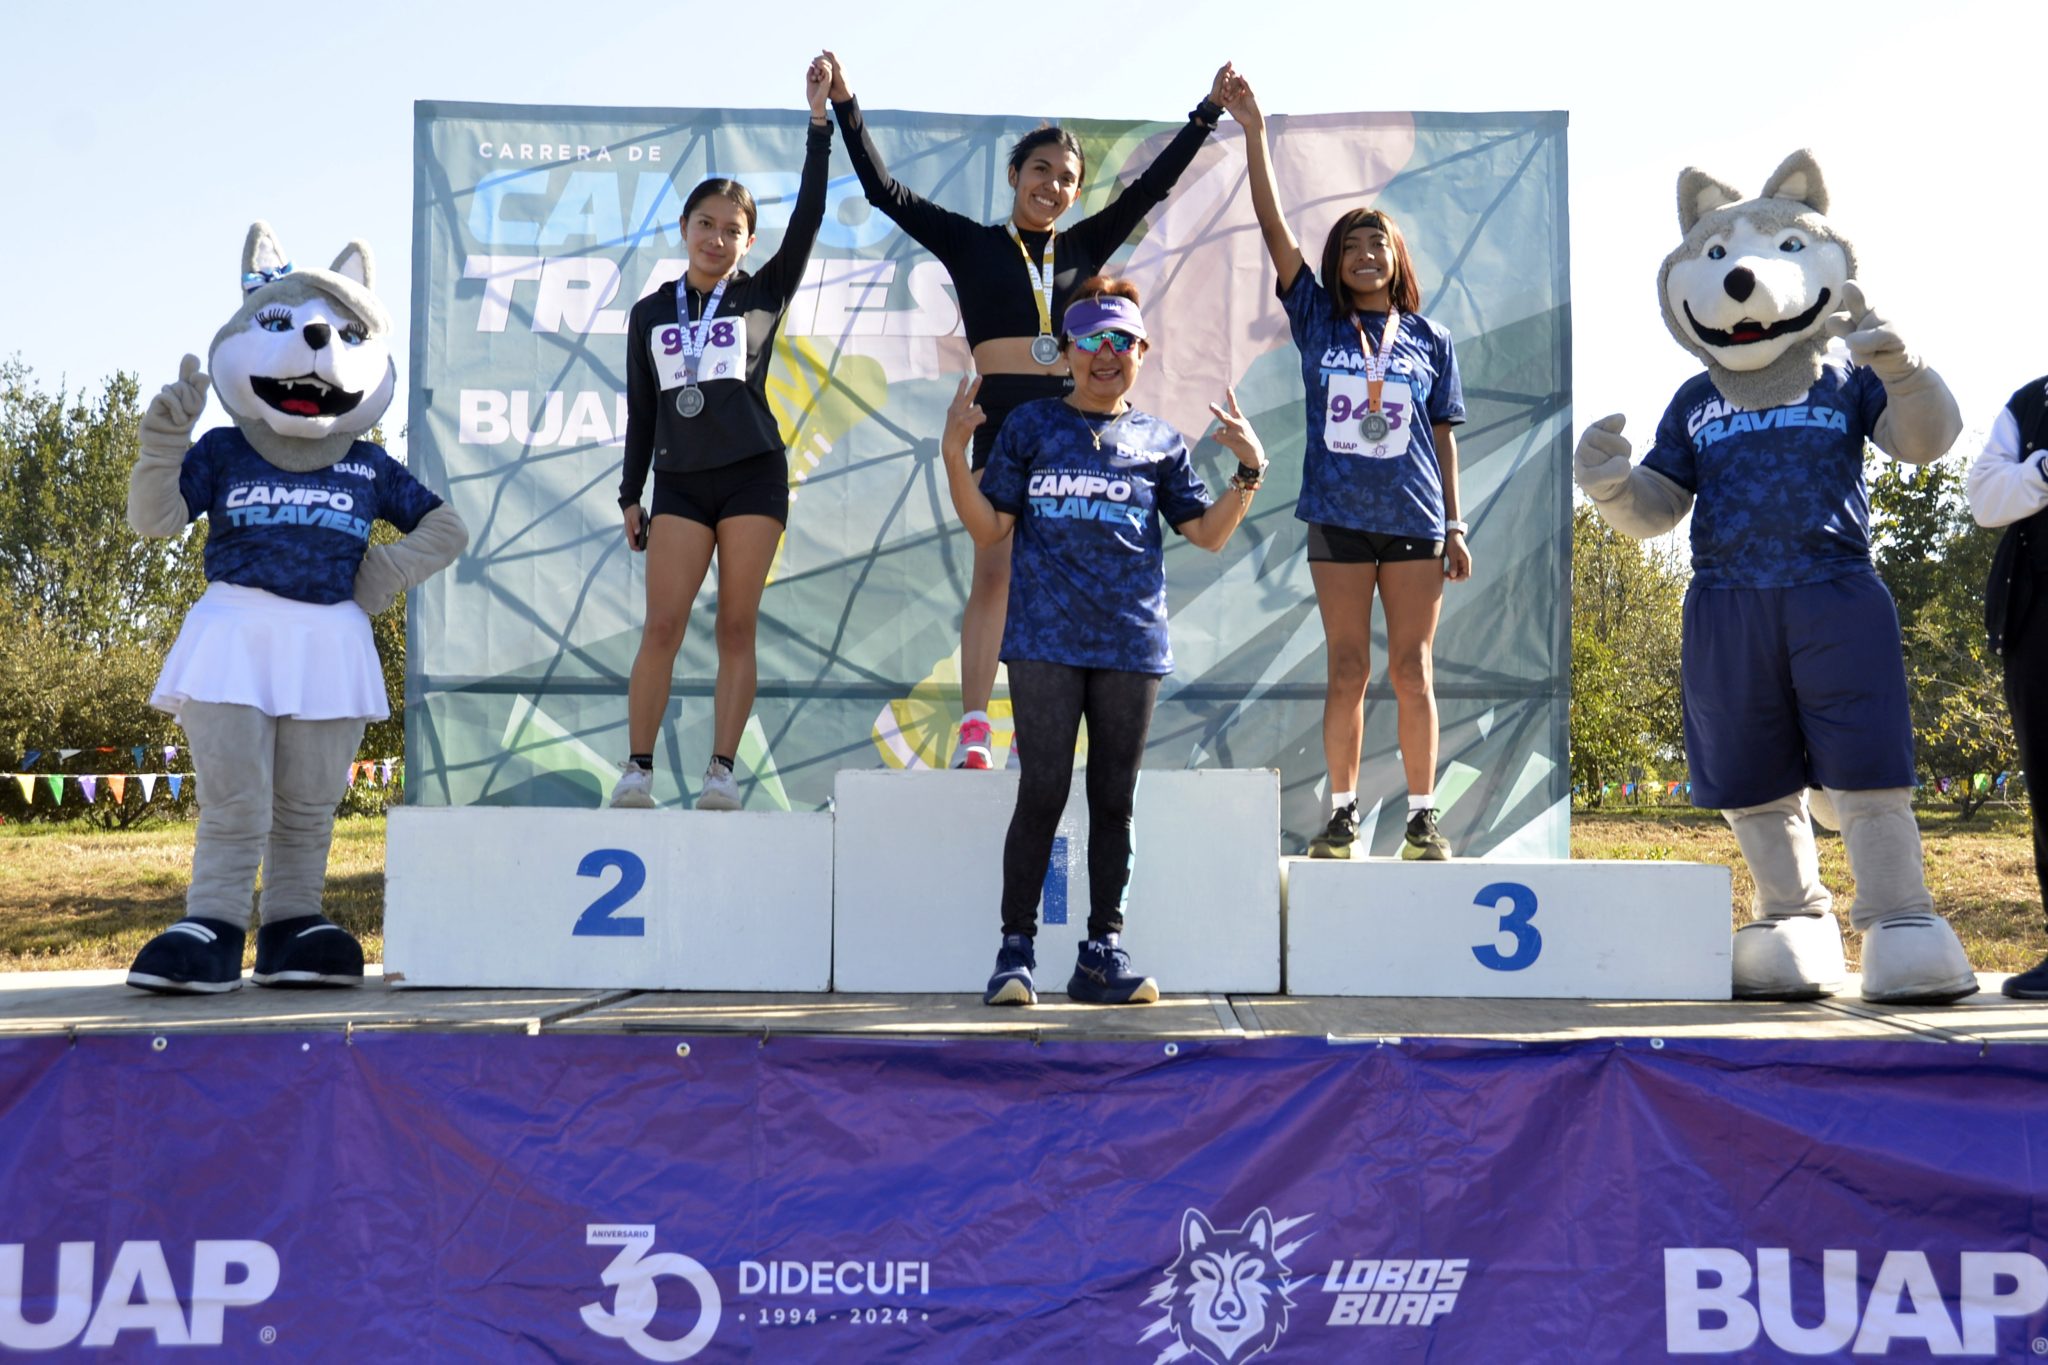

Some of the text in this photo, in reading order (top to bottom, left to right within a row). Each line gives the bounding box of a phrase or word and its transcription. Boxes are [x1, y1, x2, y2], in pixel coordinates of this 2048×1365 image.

[478, 142, 661, 162] CARRERA DE
[1693, 406, 1847, 453] TRAVIESA
[1333, 441, 1357, 450] BUAP
[333, 462, 376, 480] BUAP
[226, 486, 354, 511] CAMPO
[1028, 475, 1132, 502] CAMPO
[572, 848, 647, 937] 2
[1471, 882, 1543, 971] 3
[592, 1230, 649, 1238] ANIVERSARIO
[738, 1261, 930, 1295] DIDECUFI
[1321, 1259, 1470, 1292] LOBOS
[1325, 1292, 1459, 1326] BUAP
[1664, 1247, 2048, 1355] BUAP
[758, 1308, 818, 1325] 1994
[850, 1308, 909, 1324] 2024
